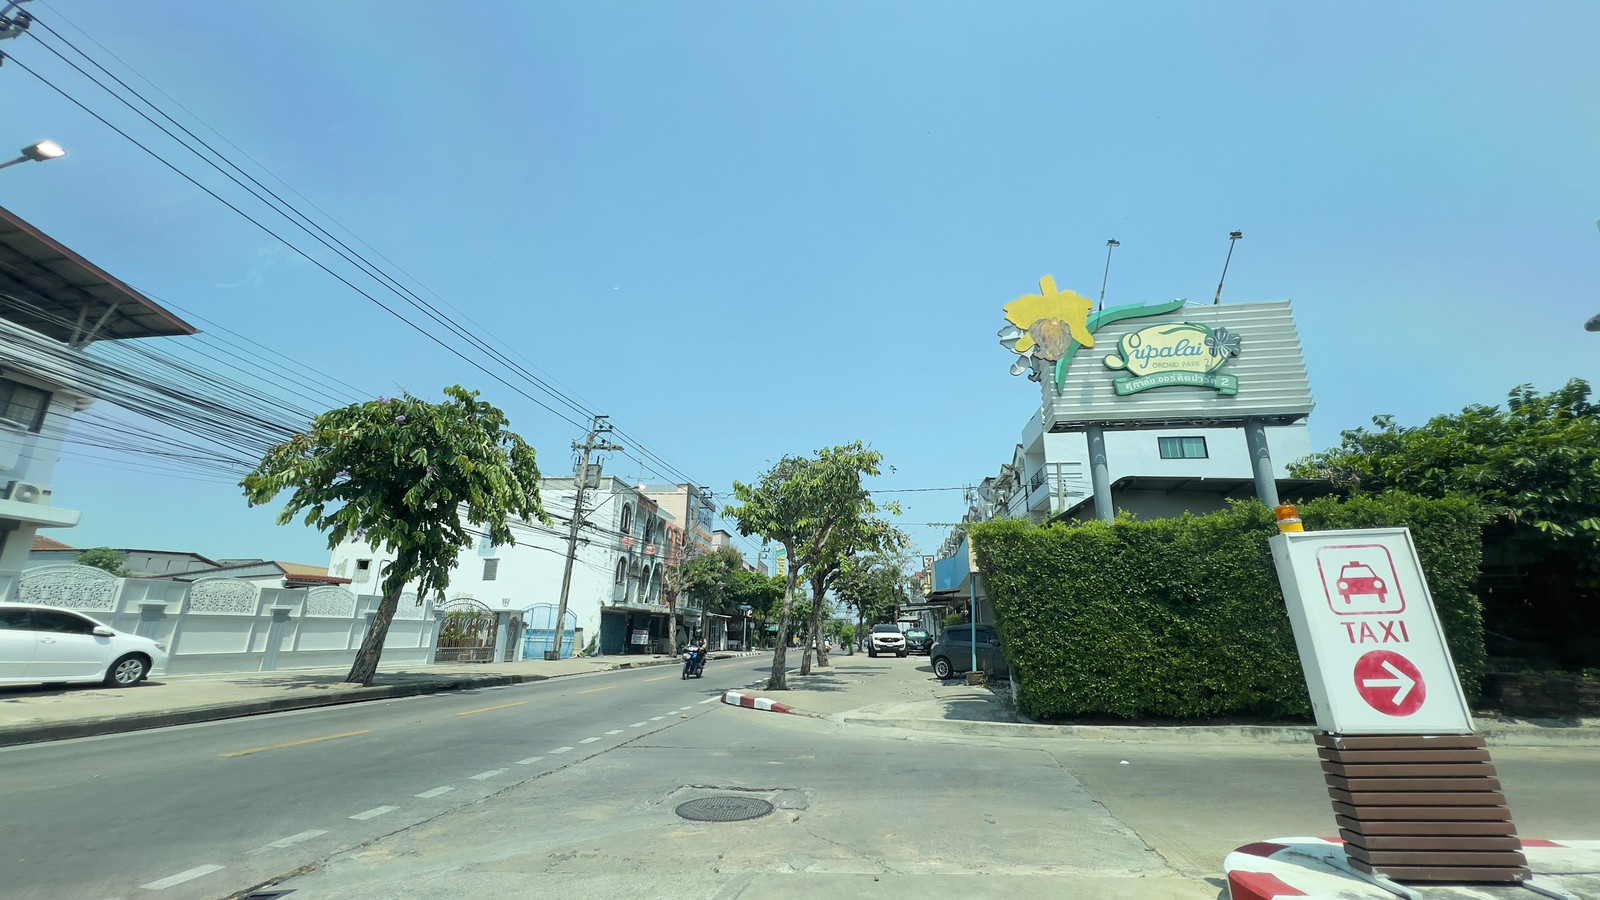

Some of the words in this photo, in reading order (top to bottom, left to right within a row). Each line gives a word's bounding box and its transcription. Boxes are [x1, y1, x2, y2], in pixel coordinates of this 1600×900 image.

[1103, 332, 1204, 369] Supalai
[1152, 361, 1180, 369] ORCHID
[1203, 358, 1211, 367] 2
[1221, 377, 1229, 386] 2
[1340, 620, 1410, 644] TAXI
